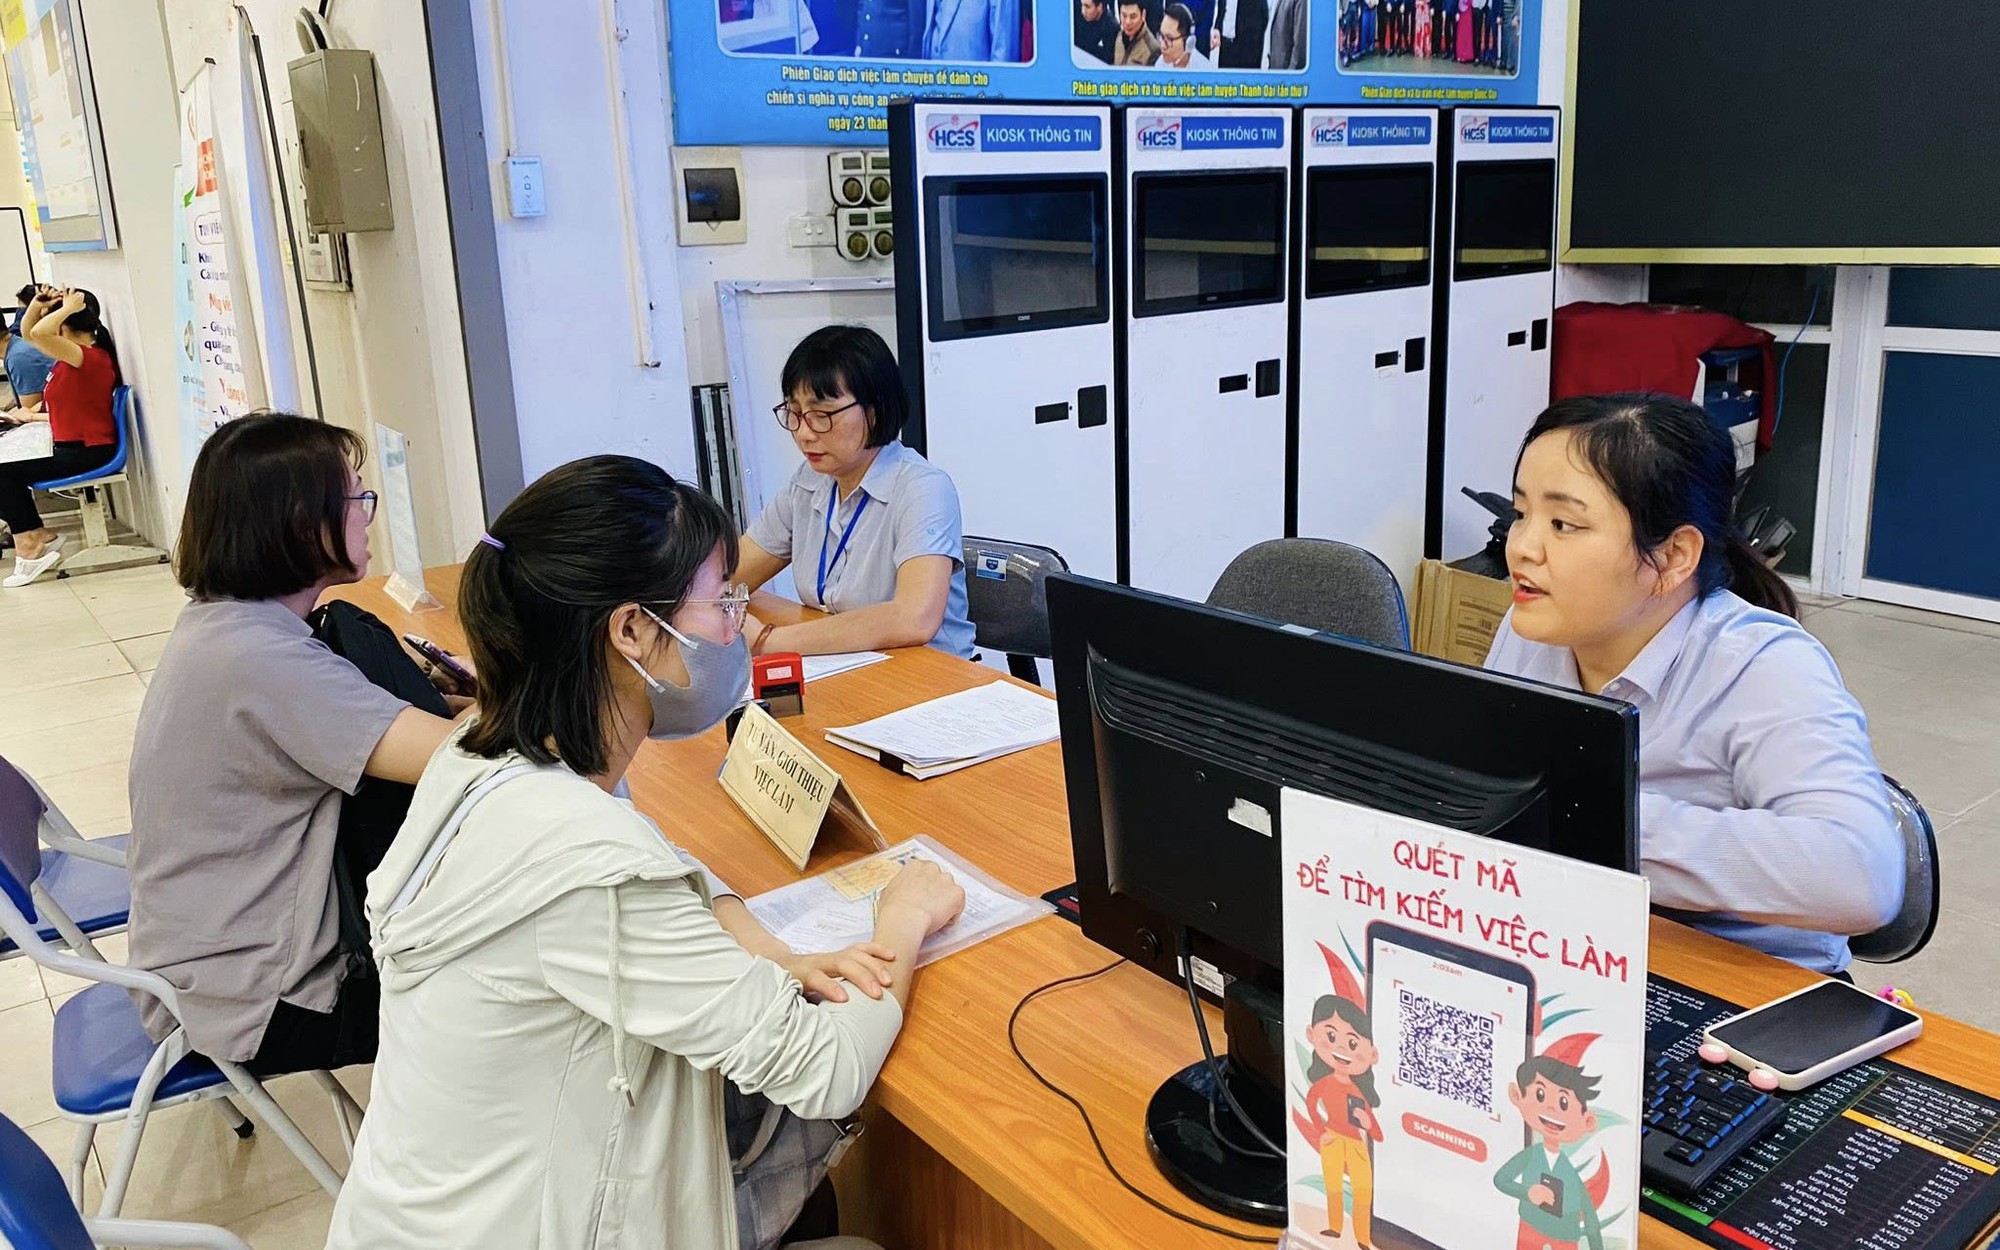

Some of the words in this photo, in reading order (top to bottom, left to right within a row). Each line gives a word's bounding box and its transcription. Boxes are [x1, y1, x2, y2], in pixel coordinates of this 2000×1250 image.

[782, 65, 810, 80] Phiên
[813, 67, 834, 82] Giao
[837, 68, 858, 85] dịch
[860, 69, 880, 86] việc
[882, 69, 900, 84] làm
[973, 72, 988, 86] cho
[1100, 84, 1118, 98] giao
[1121, 84, 1138, 98] dịch
[1180, 83, 1196, 99] việc
[1240, 84, 1260, 96] Thanh
[766, 88, 794, 105] chiến
[838, 92, 849, 109] vụ
[852, 91, 875, 108] công
[877, 95, 888, 106] an
[828, 117, 850, 132] ngày
[854, 117, 864, 130] 23
[868, 116, 888, 131] thán
[987, 128, 1025, 142] KIOSK
[1029, 125, 1071, 142] THÔNG
[1074, 129, 1092, 142] TIN
[1187, 129, 1219, 141] KIOSK
[1222, 125, 1258, 141] THÔNG
[1261, 128, 1277, 140] TIN
[1316, 129, 1344, 142] HCES
[1352, 126, 1379, 138] KIOSK
[1381, 124, 1410, 138] THÔNG
[1413, 126, 1426, 137] TIN
[1464, 128, 1485, 140] HCES
[1491, 126, 1513, 137] KIOSK
[1514, 125, 1537, 136] THÔNG
[1540, 126, 1549, 136] TIN
[935, 130, 975, 146] HCES
[1143, 130, 1176, 146] HCES
[776, 750, 798, 778] GIỚI
[797, 766, 828, 803] THIỆU
[754, 765, 775, 795] VIỆC
[771, 784, 794, 813] LÀM
[1394, 840, 1464, 880] QUÉT
[1476, 860, 1522, 898] MÃ
[1296, 854, 1330, 896] ĐỂ
[1340, 872, 1386, 910] TÌM
[1396, 888, 1463, 934] KIẾM
[1476, 914, 1550, 960] VIỆC
[1562, 936, 1628, 983] LÀM
[1432, 962, 1462, 977] 2:03am
[1880, 1093, 1899, 1102] theo
[1896, 1106, 1912, 1115] Pen
[1784, 1124, 1797, 1132] Tab
[1924, 1117, 1948, 1128] Công
[1413, 1120, 1476, 1152] SCANNING
[1844, 1172, 1859, 1182] Tạo
[1940, 1167, 1968, 1180] Ctrl+U
[1780, 1182, 1794, 1191] tác
[1808, 1176, 1830, 1188] kiếm
[1833, 1177, 1854, 1189] Thay
[1796, 1189, 1819, 1202] hoàn
[1808, 1185, 1821, 1194] tất
[1832, 1186, 1848, 1196] Tìm
[1771, 1198, 1790, 1209] biệt
[1787, 1195, 1801, 1204] tác
[1822, 1191, 1846, 1204] Chọn
[1791, 1206, 1808, 1216] đặc
[1803, 1202, 1827, 1216] Hoàn
[1819, 1200, 1846, 1215] Trước
[1900, 1206, 1928, 1220] Ctrl+H
[1907, 1199, 1935, 1214] Ctrl+N
[1776, 1221, 1792, 1231] Cắt
[1783, 1214, 1802, 1225] Dán
[1809, 1215, 1828, 1226] Dán
[1756, 1222, 1779, 1235] chép
[1887, 1220, 1914, 1235] Ctrl+A
[1780, 1234, 1798, 1244] Sao
[1872, 1234, 1900, 1249] Ctrl+Z
